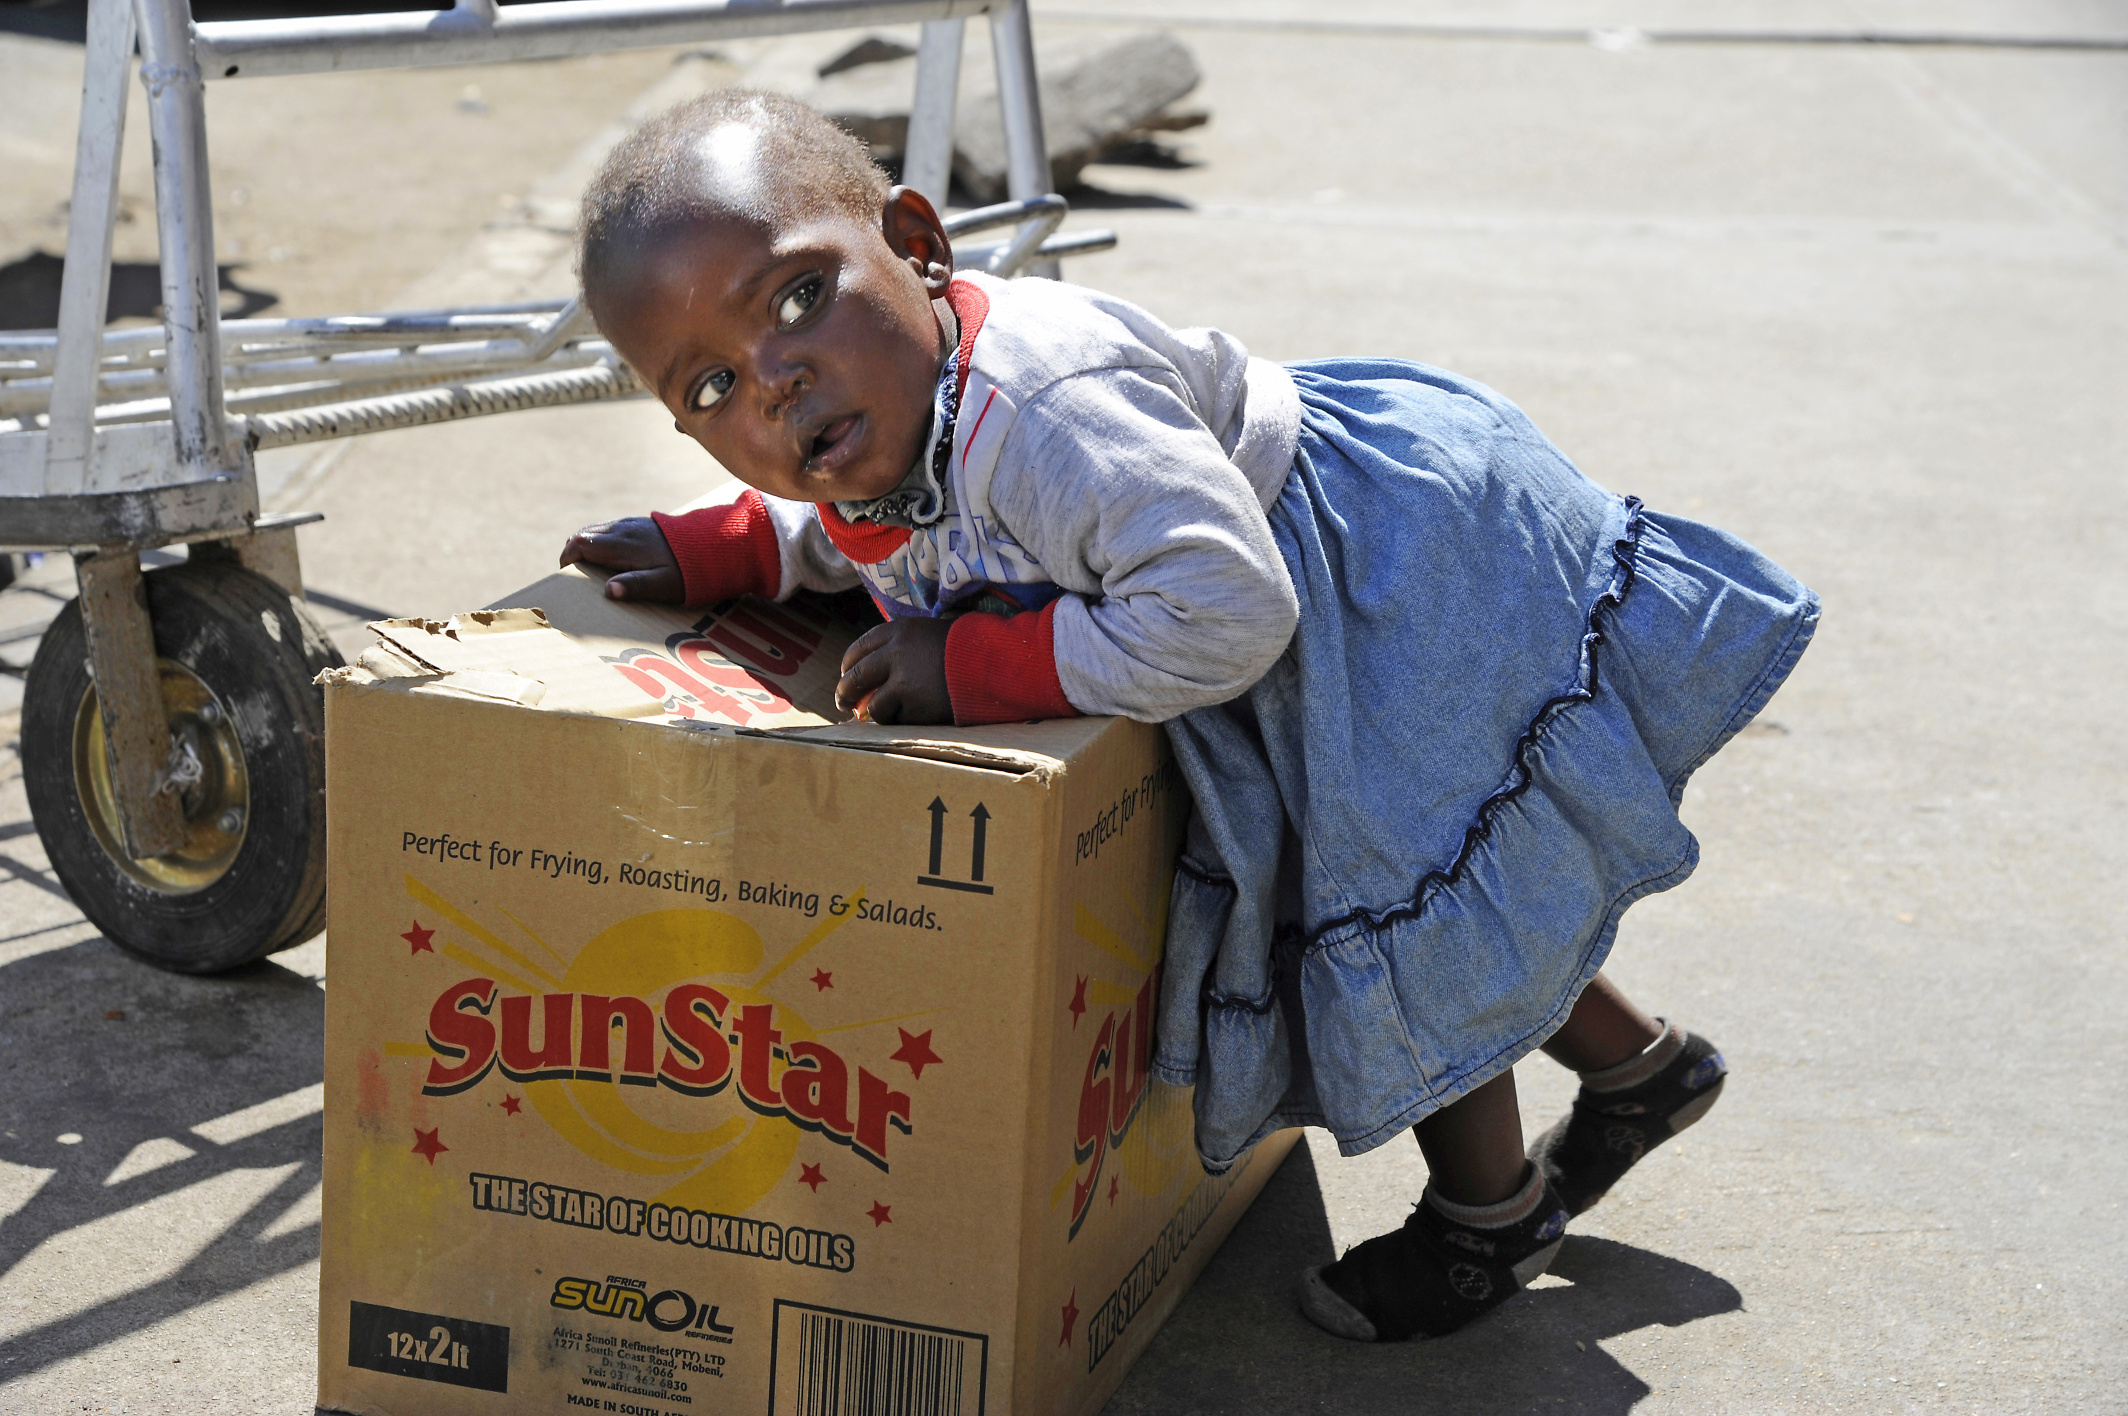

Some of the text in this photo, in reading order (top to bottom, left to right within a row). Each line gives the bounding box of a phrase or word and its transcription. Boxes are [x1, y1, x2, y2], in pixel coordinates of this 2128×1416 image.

[1076, 801, 1118, 866] Perfect
[1121, 788, 1138, 836] for
[402, 831, 943, 931] Perfect for Frying, Roasting, Baking & Salads.
[421, 977, 912, 1174] SunStar
[469, 1172, 854, 1273] THE STAR OF COOKING OILS
[606, 1275, 647, 1289] AFRICA
[1088, 1289, 1118, 1374] THE
[1117, 1245, 1154, 1335] STAR
[553, 1327, 582, 1341] Africa
[586, 1333, 617, 1347] Sunoil
[704, 1353, 726, 1366] LTD
[685, 1330, 733, 1344] REFINERIES
[554, 1339, 724, 1378] 1271 South Coast Road, Mobeni,
[645, 1365, 674, 1379] 4066
[582, 1377, 692, 1404] www.africasunoil.com
[587, 1366, 606, 1377] Tel:
[659, 1377, 688, 1392] 6830
[567, 1394, 600, 1409] MADE
[604, 1401, 617, 1412] IN
[620, 1404, 659, 1416] SOUTH
